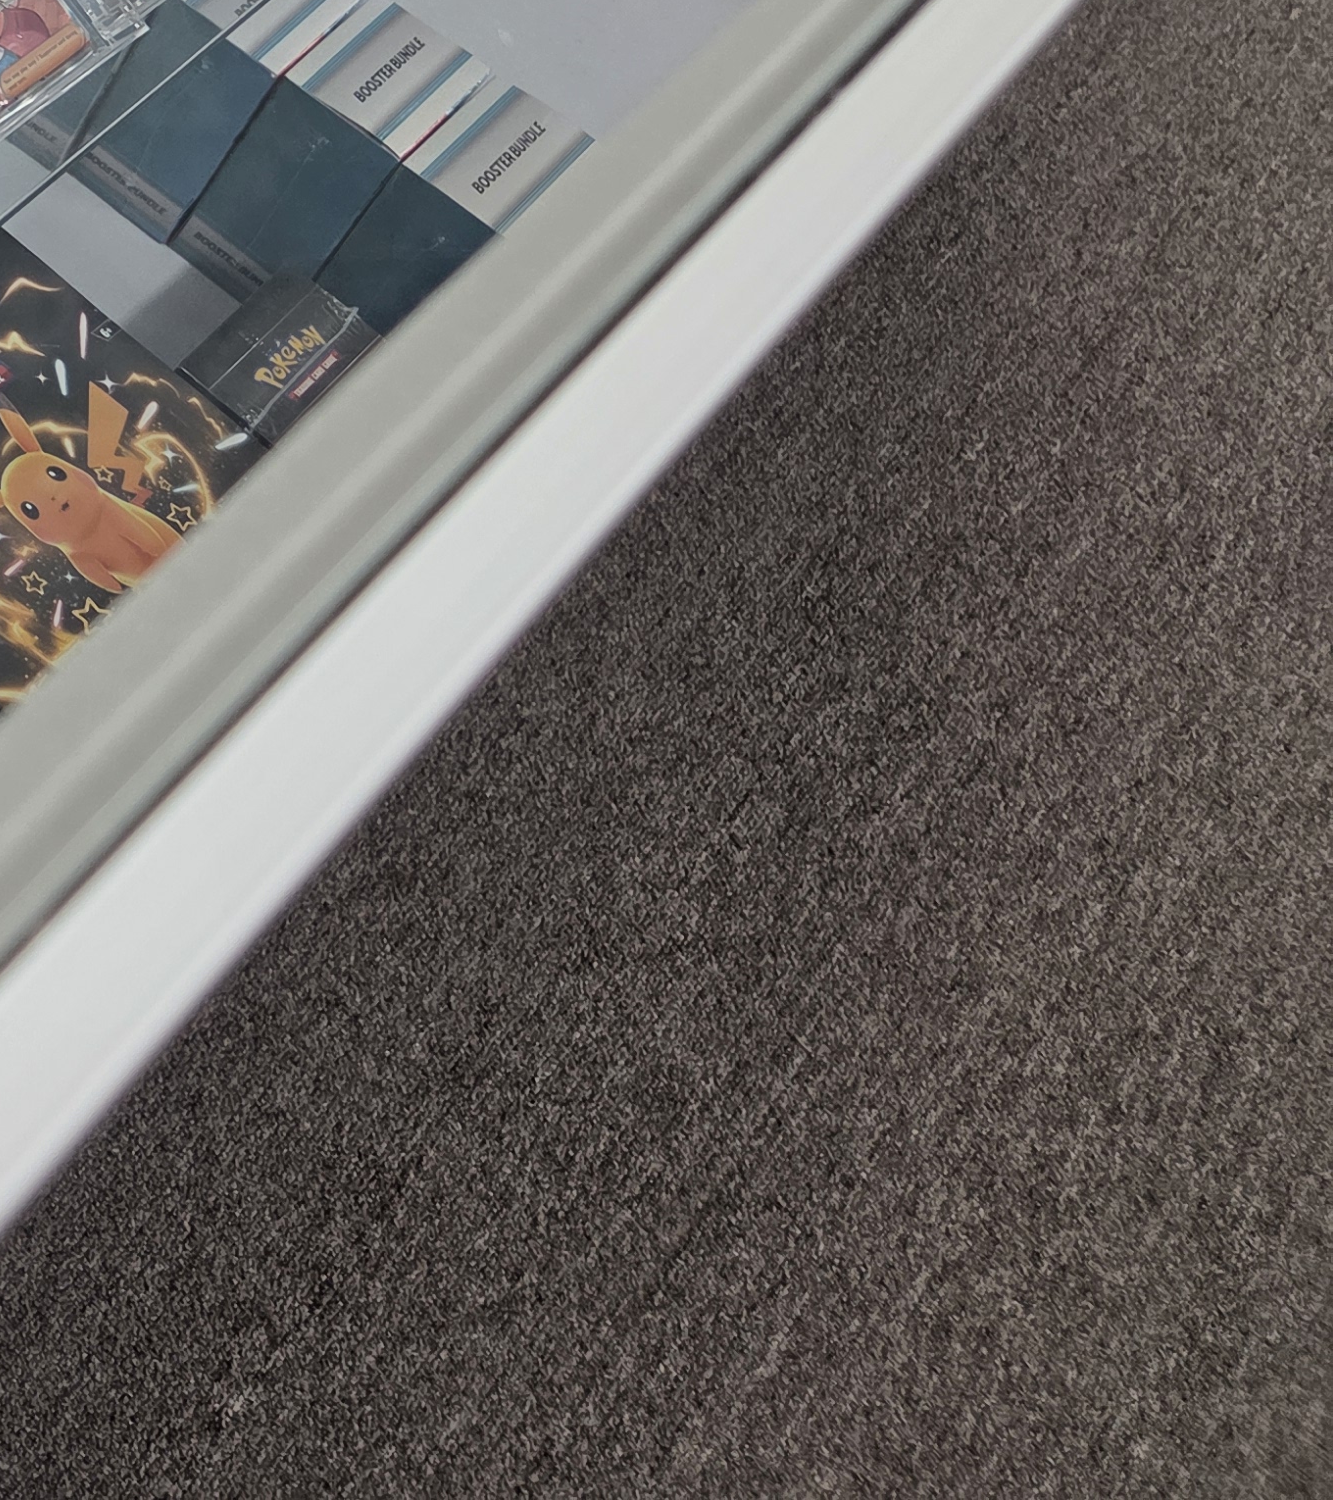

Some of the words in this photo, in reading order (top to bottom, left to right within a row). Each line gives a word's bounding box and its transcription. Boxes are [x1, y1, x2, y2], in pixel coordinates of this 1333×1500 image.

[353, 62, 397, 104] BOOSTER
[393, 36, 427, 71] BUNDLE
[470, 152, 517, 196] BOOSTER
[512, 119, 547, 160] BUNDLE
